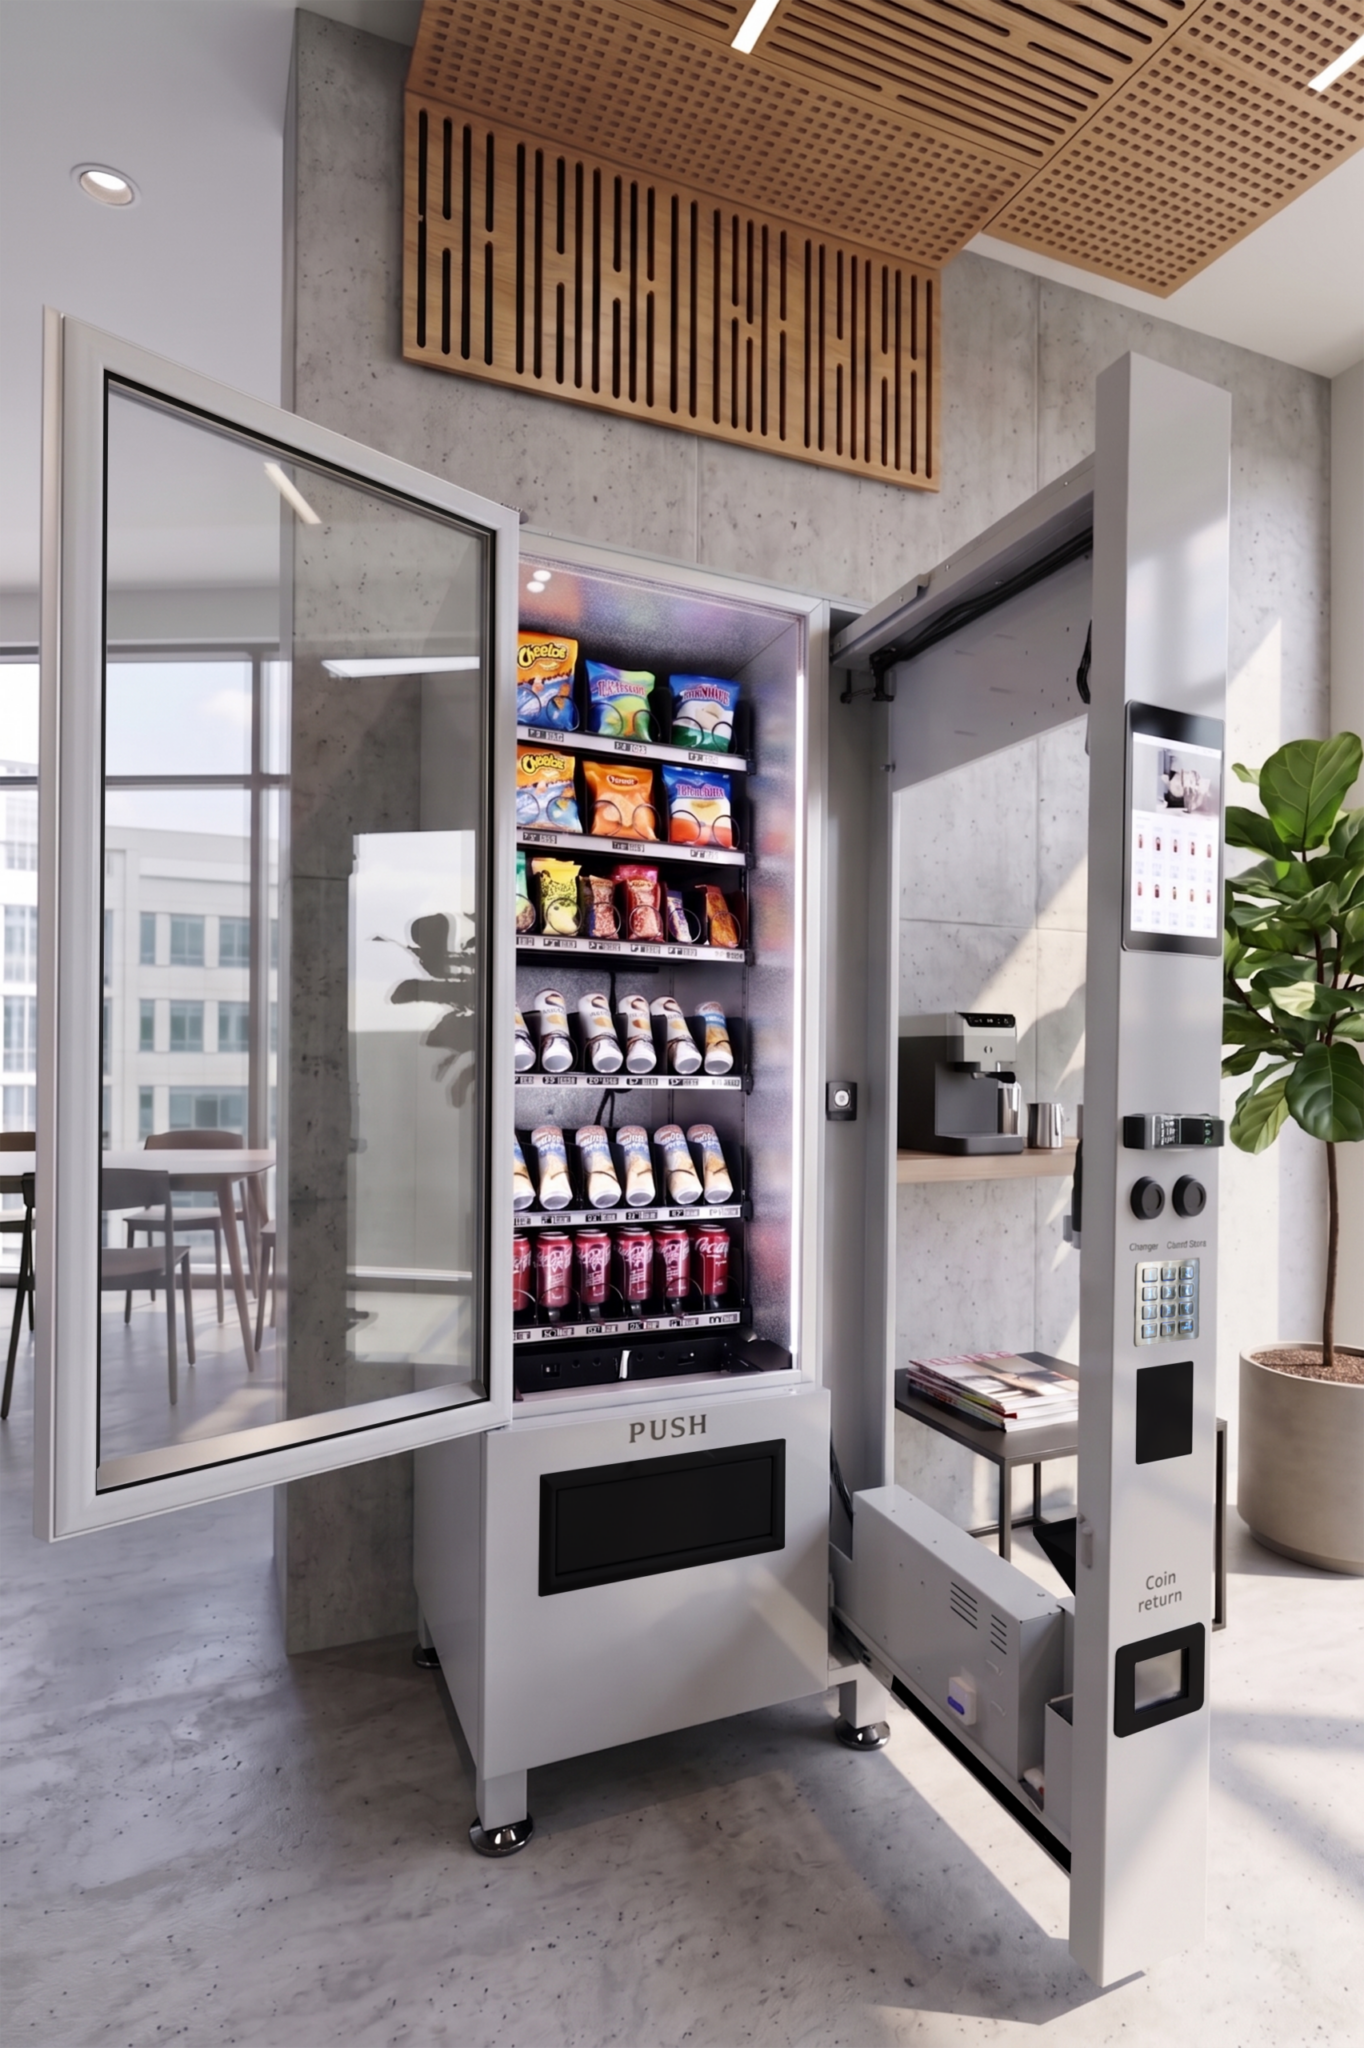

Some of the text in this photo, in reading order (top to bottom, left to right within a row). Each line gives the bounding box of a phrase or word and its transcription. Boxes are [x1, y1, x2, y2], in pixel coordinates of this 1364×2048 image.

[629, 1414, 707, 1443] PUSH
[1145, 1571, 1176, 1590] Coin
[1138, 1590, 1182, 1612] return
